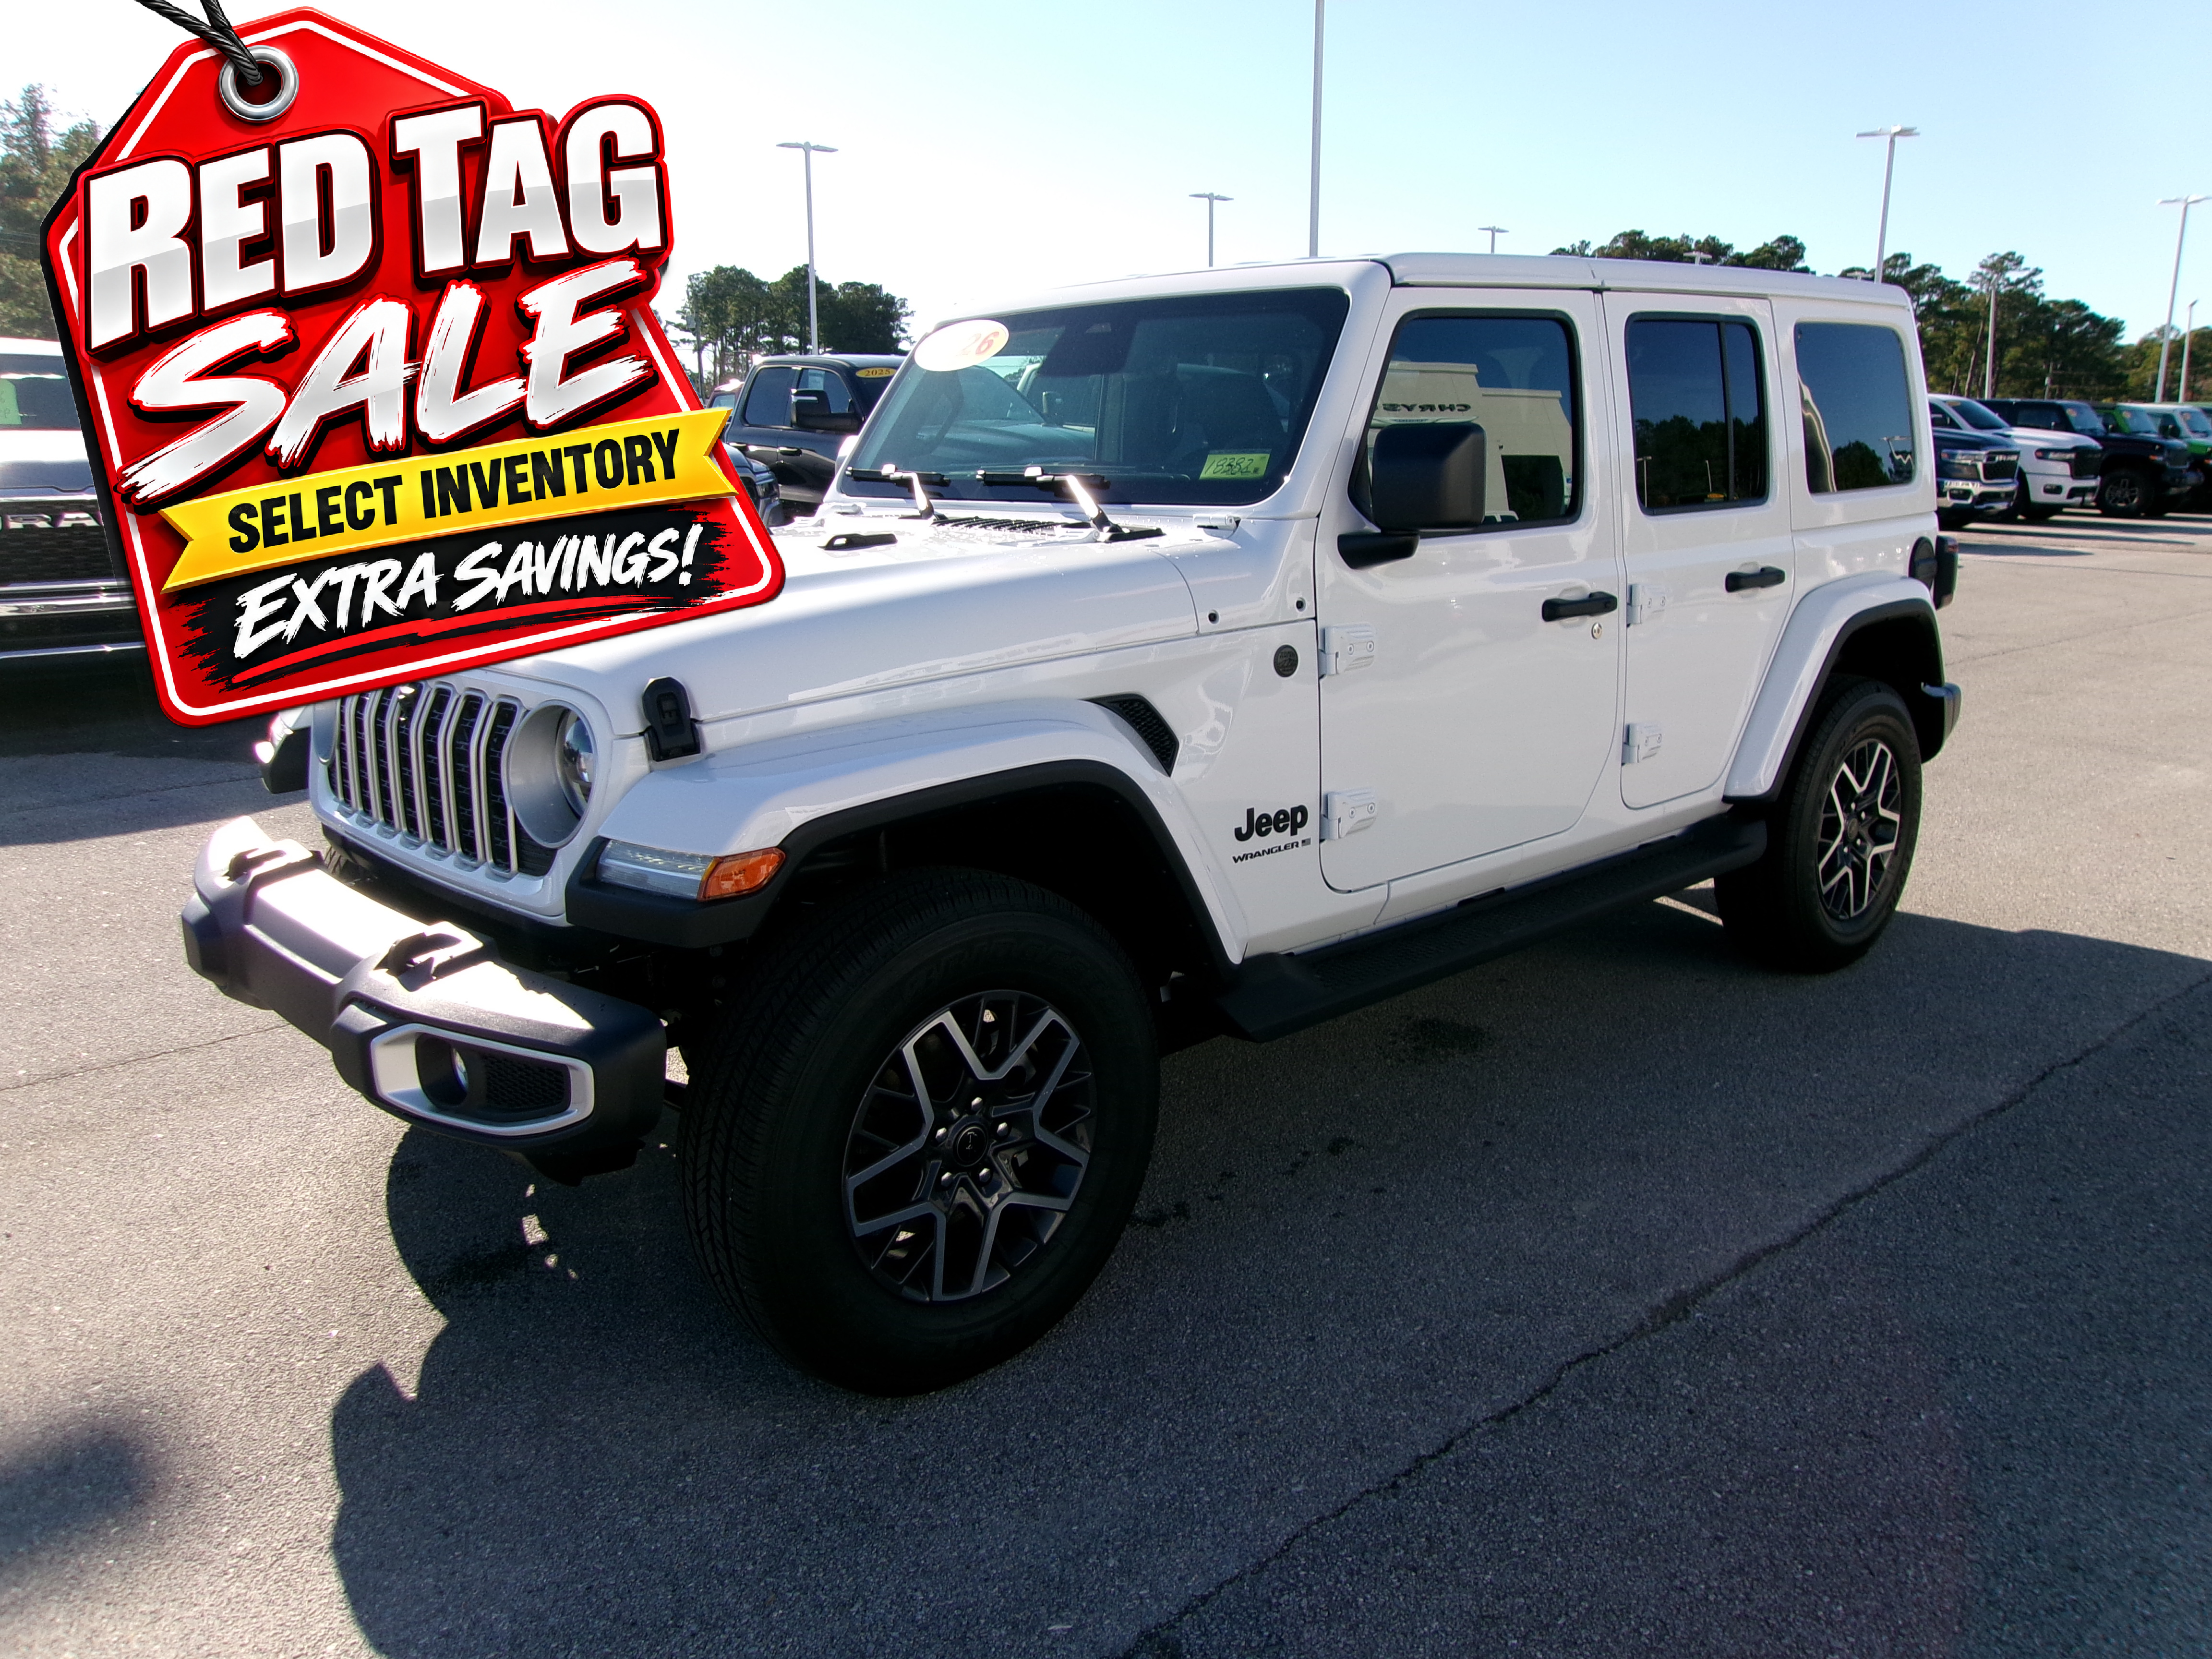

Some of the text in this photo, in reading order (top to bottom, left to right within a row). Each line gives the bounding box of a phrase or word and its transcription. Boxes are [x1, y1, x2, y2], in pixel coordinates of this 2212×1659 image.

[865, 368, 890, 376] 2025
[1234, 805, 1308, 842] Jeep
[1232, 841, 1299, 864] WRANGLER
